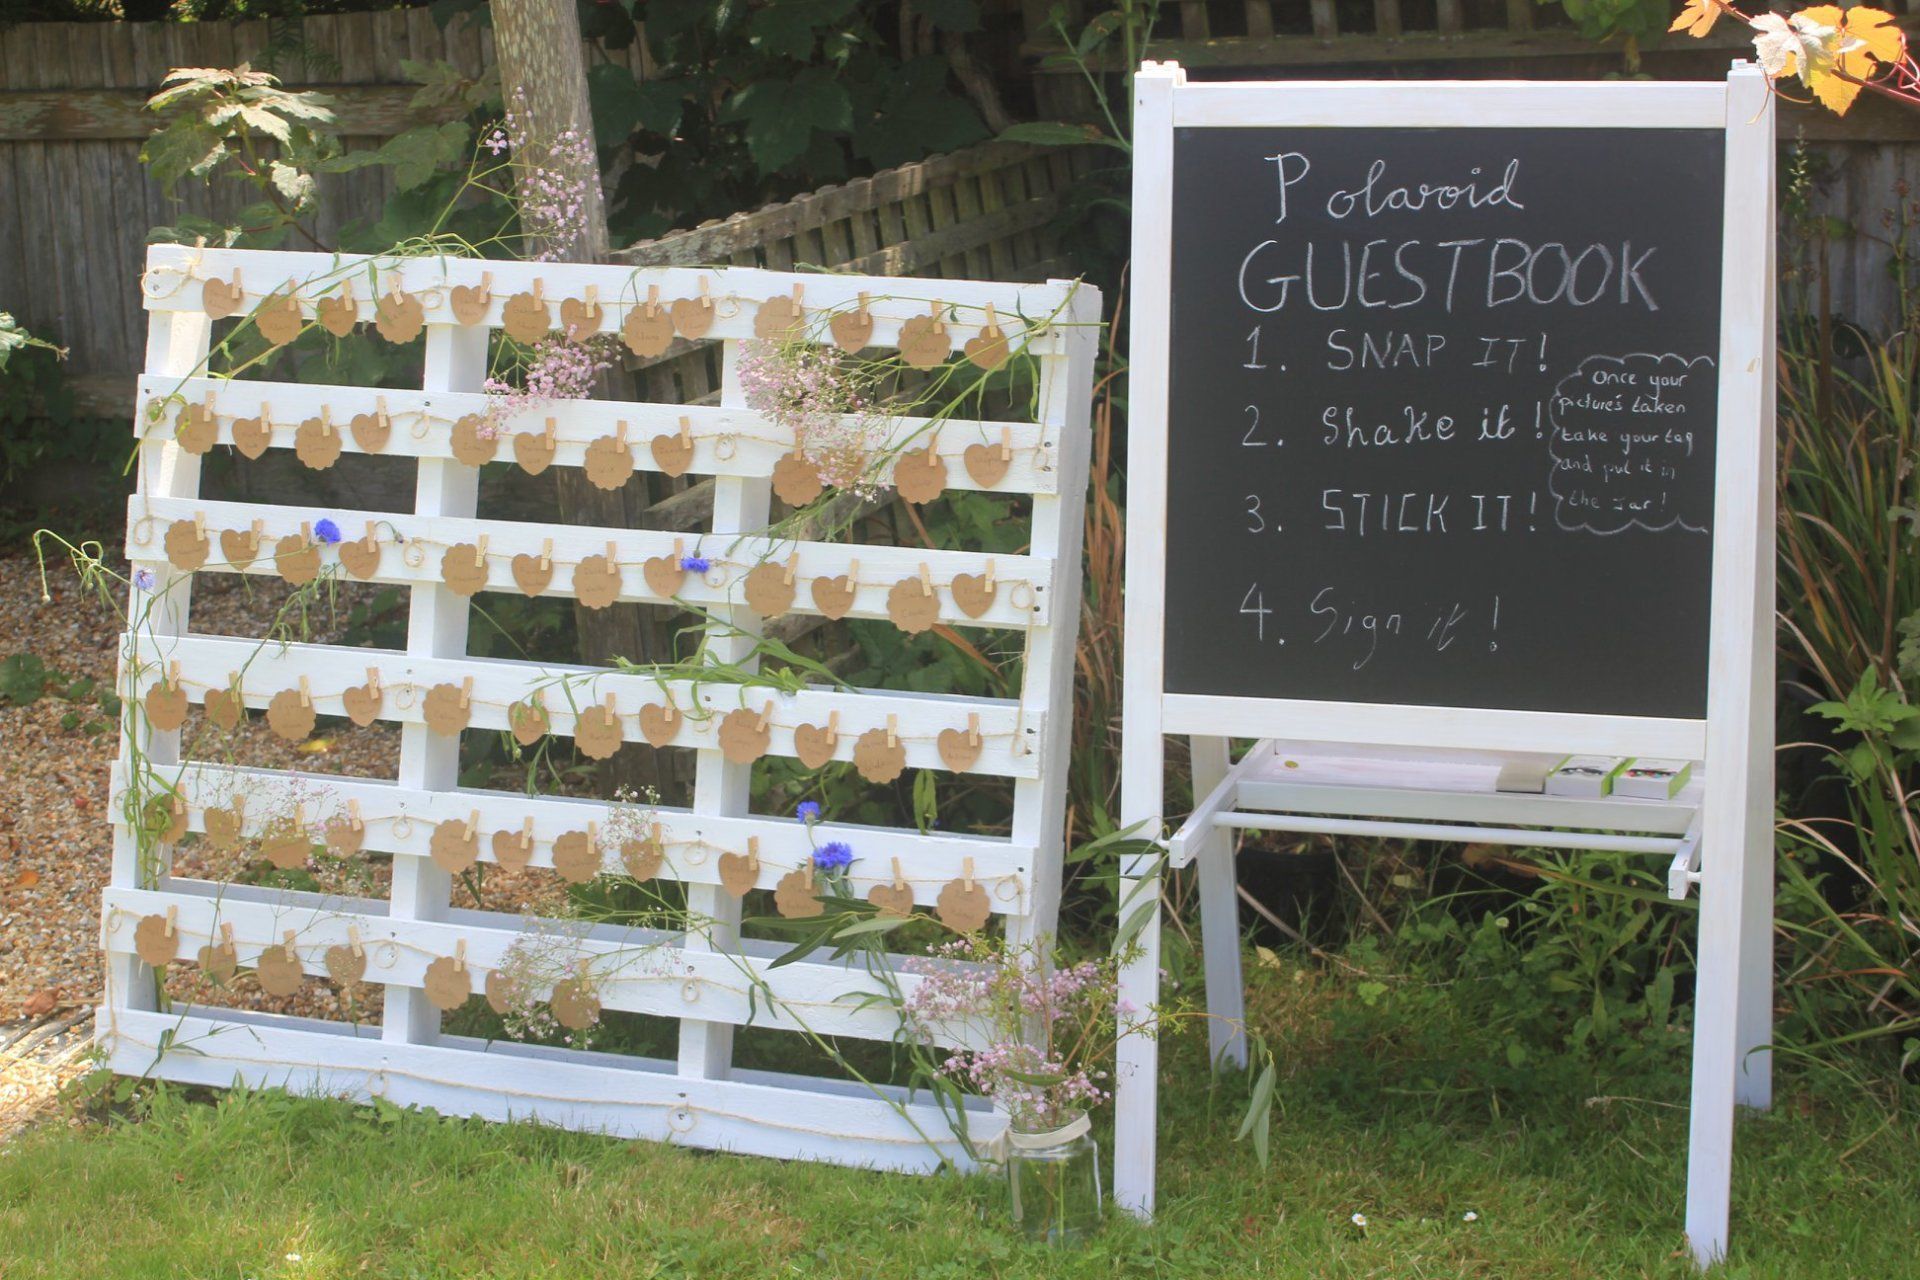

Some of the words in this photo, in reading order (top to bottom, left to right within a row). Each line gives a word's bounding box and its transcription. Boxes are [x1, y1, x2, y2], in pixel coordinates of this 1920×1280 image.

[1237, 237, 1660, 314] GUESTBOOK
[1242, 324, 1287, 372] 1.
[1326, 328, 1447, 372] SNAP
[1591, 370, 1638, 386] Once
[1647, 374, 1689, 401] your
[1630, 395, 1687, 415] taken
[1241, 404, 1284, 447] 2.
[1321, 404, 1456, 449] Shake
[1560, 426, 1609, 443] take
[1619, 432, 1660, 456] your
[1664, 428, 1694, 457] tag
[1561, 454, 1593, 473] and
[1602, 459, 1632, 484] put
[1245, 493, 1283, 534] 3.
[1321, 488, 1450, 537] STICK
[1568, 489, 1601, 510] the
[1238, 582, 1286, 646] 4.
[1310, 586, 1402, 671] Sign
